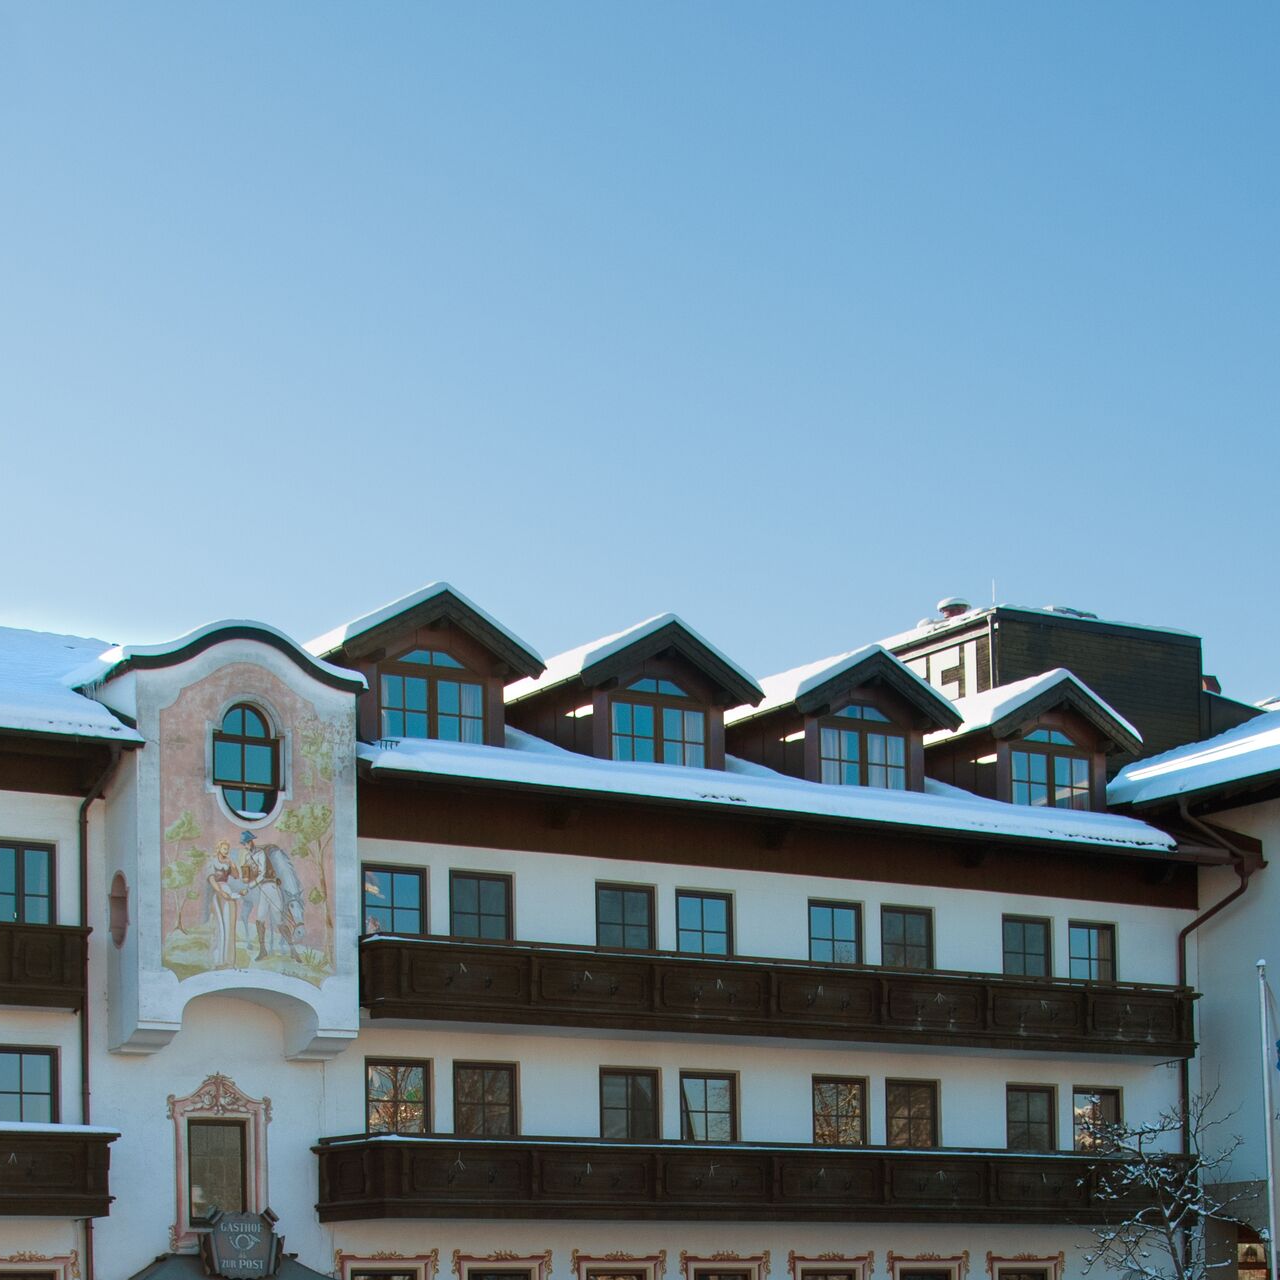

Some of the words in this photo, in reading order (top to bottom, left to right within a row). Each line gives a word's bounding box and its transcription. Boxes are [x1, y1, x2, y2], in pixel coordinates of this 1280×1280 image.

[220, 1222, 263, 1233] GASTHOF
[221, 1259, 237, 1269] ZUR
[239, 1259, 264, 1270] POST
